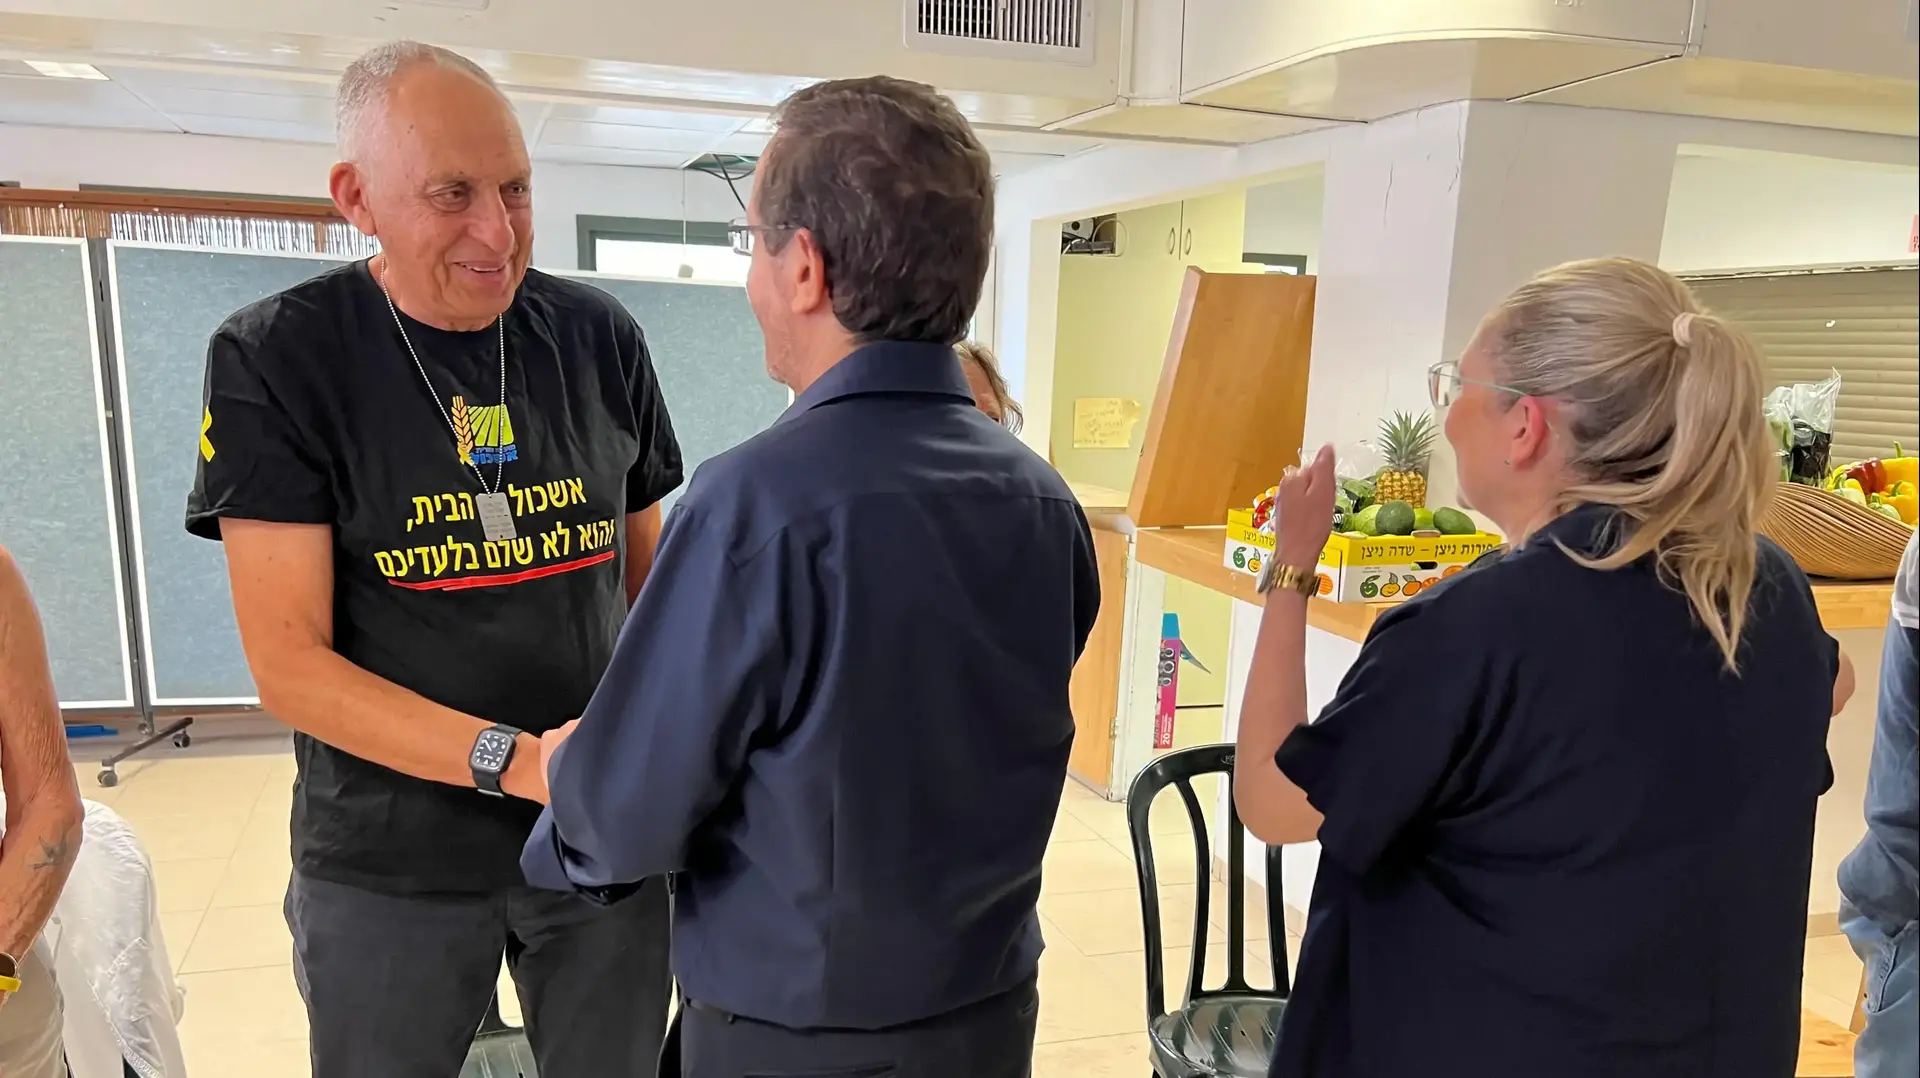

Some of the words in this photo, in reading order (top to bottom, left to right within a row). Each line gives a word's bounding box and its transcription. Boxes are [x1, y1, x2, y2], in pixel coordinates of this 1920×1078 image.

[406, 492, 475, 532] הבית,
[507, 477, 587, 516] אשכול
[540, 521, 570, 559] לא
[576, 518, 615, 551] והוא
[1434, 544, 1457, 558] ניצן
[373, 536, 480, 578] בלעדיכם
[483, 537, 534, 569] שלם
[1361, 546, 1384, 560] ניצן
[1389, 546, 1416, 557] שדה
